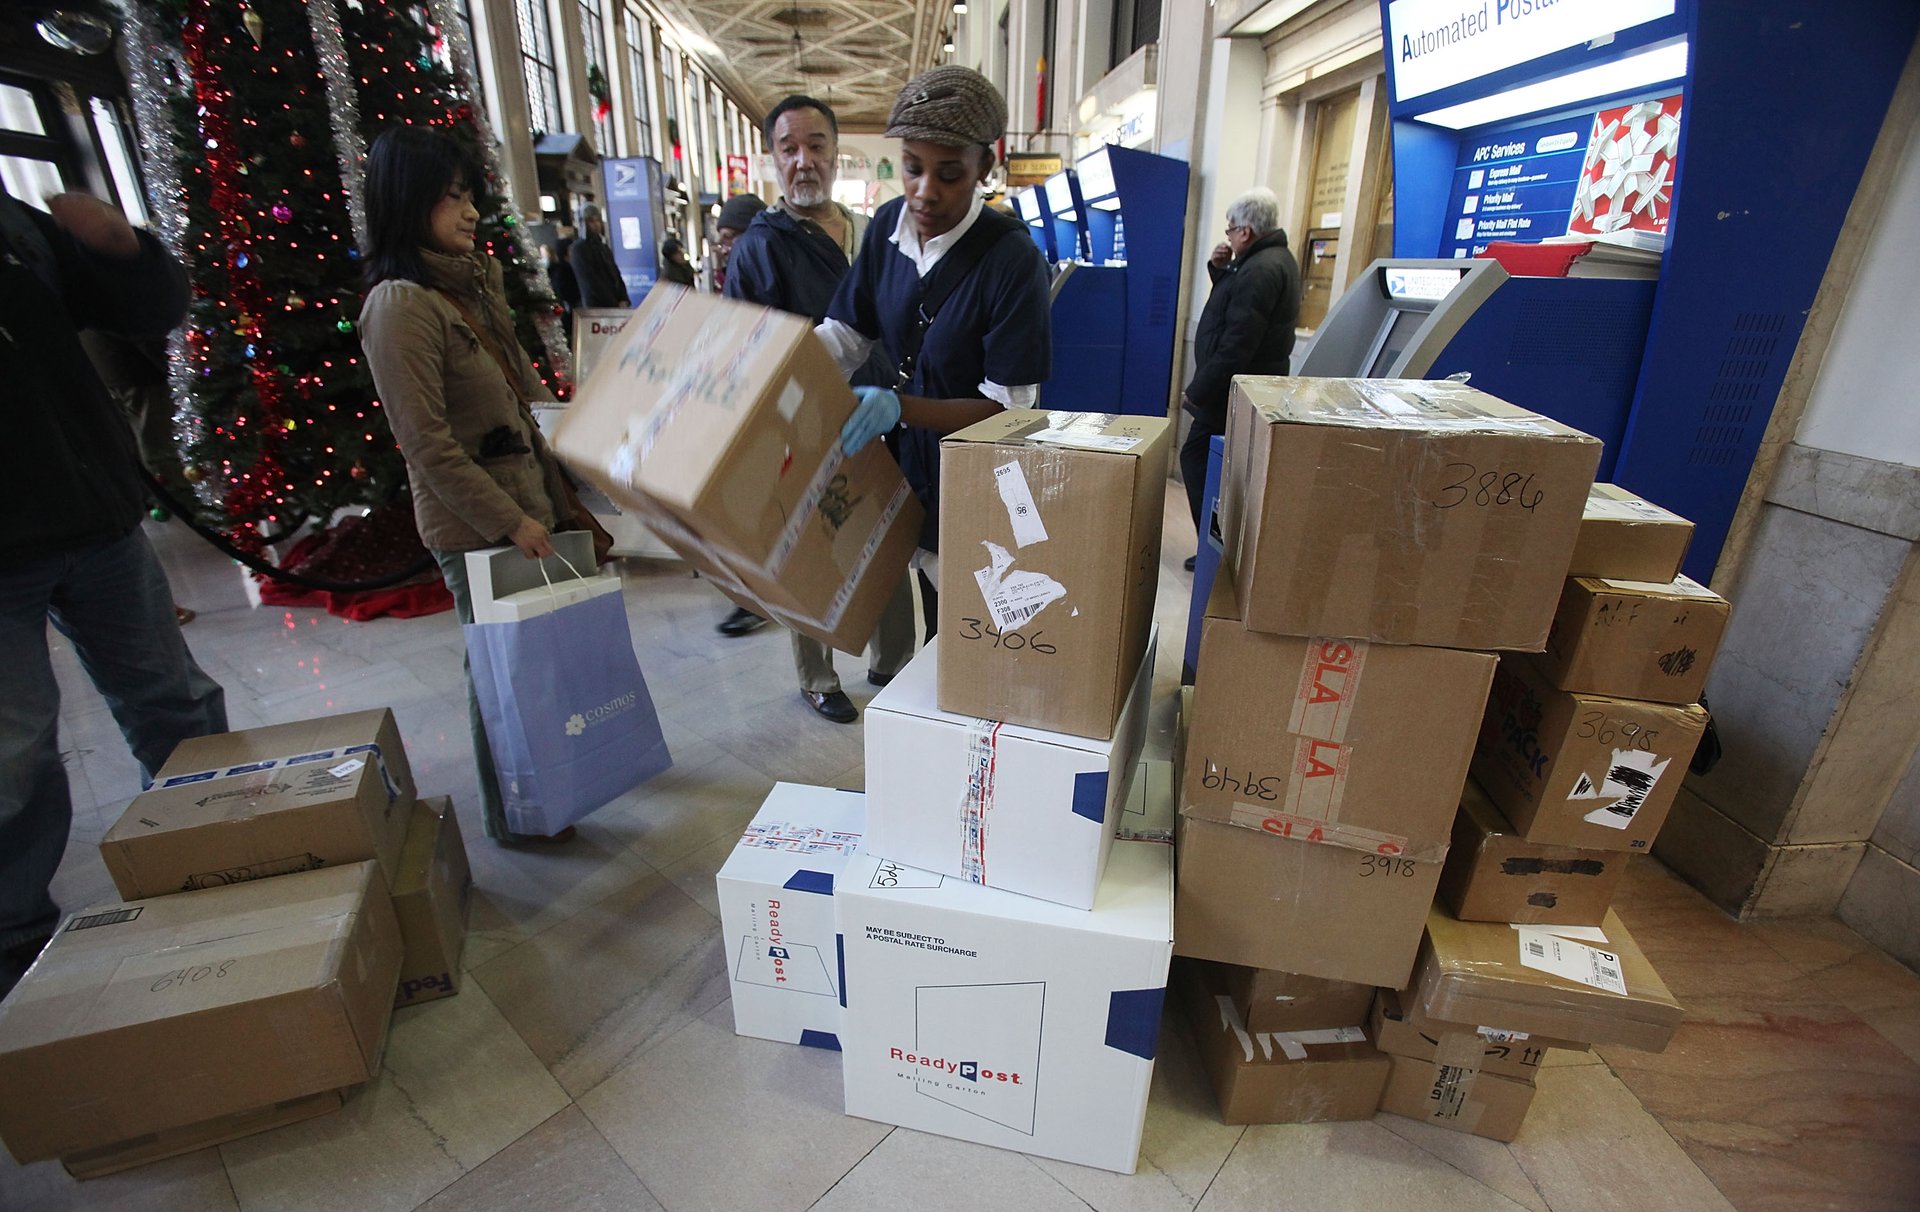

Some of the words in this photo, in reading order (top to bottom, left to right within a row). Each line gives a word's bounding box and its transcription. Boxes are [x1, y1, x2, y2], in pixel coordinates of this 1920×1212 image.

[1402, 9, 1488, 62] Automated
[1497, 0, 1559, 25] Pos
[1473, 146, 1491, 162] APC
[1491, 142, 1526, 159] Services
[1031, 158, 1059, 172] SERVICE
[1432, 462, 1544, 514] 3886
[959, 617, 1057, 655] 3406
[1576, 711, 1660, 751] 3698
[1202, 757, 1281, 801] 3949
[1630, 839, 1646, 849] 20
[1359, 854, 1416, 878] 3918
[865, 925, 883, 935] MAY
[883, 928, 895, 937] BE
[896, 931, 933, 944] SUBJECT
[933, 937, 945, 945] TO
[873, 934, 904, 946] POSTAL
[904, 939, 926, 949] RATE
[926, 943, 978, 958] SURCHARGE
[150, 958, 237, 993] 6408
[897, 1072, 940, 1087] Mailing
[946, 1083, 986, 1096] Carton
[1431, 1089, 1443, 1101] LD
